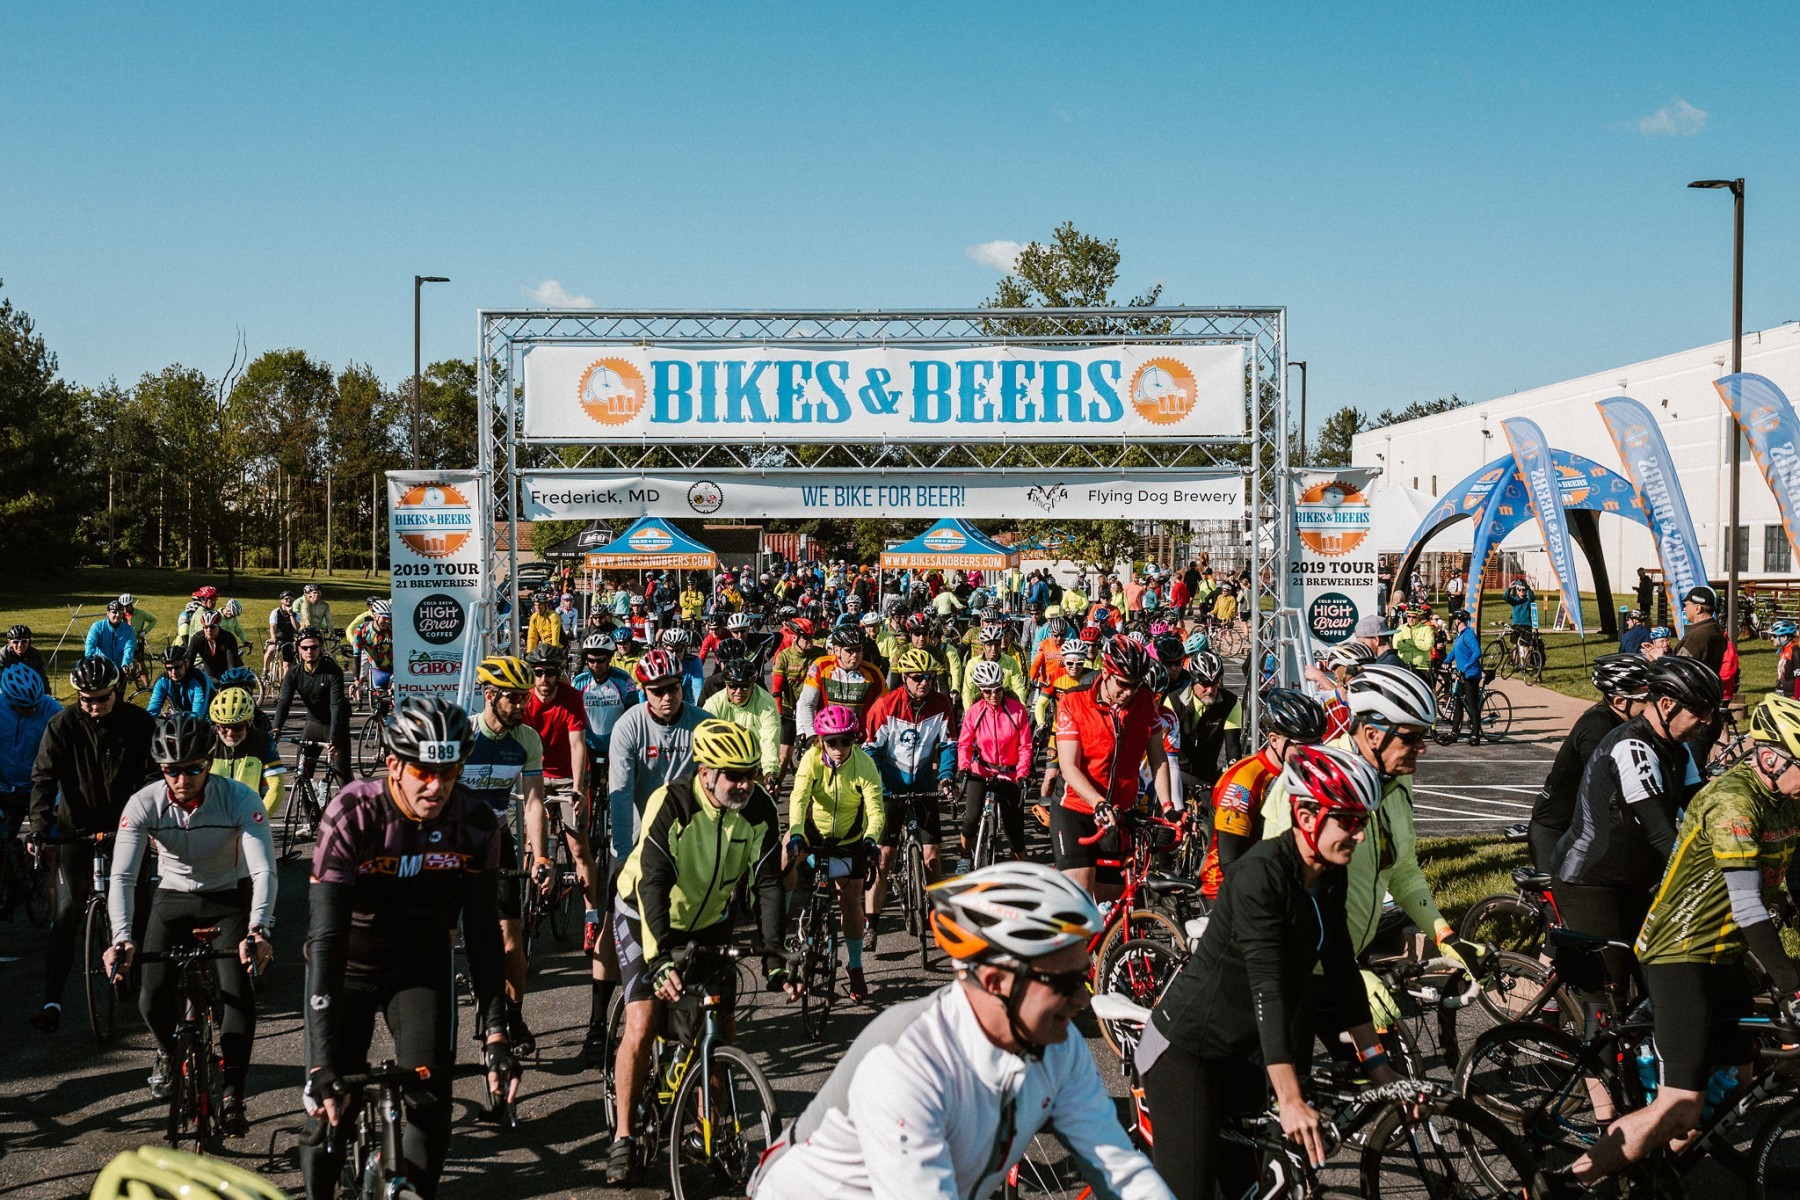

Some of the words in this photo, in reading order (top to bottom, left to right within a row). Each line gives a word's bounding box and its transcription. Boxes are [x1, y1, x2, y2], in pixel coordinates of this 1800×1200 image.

[650, 359, 852, 424] BIKES
[858, 367, 903, 415] &
[909, 360, 1125, 424] BEERS
[1563, 479, 1588, 488] BEERS
[531, 489, 622, 505] Frederick,
[628, 488, 660, 504] MD
[801, 486, 829, 507] WE
[834, 486, 874, 507] BIKE
[878, 486, 912, 507] FOR
[917, 486, 965, 507] BEER!
[1088, 490, 1133, 504] Flying
[1138, 490, 1168, 505] Dog
[1173, 490, 1237, 505] Brewery
[395, 514, 428, 525] BIKES
[429, 516, 436, 524] &
[437, 513, 471, 524] BEERS
[1295, 511, 1326, 523] BIKES
[1327, 513, 1333, 522] &
[1334, 511, 1370, 523] BEERS
[589, 555, 712, 567] WWW.BIKESANDBEERS.COM
[884, 556, 1002, 568] WWW.BIKESANDBEERS.COM
[393, 564, 430, 576] 2019
[433, 563, 479, 575] TOUR
[1291, 561, 1326, 574] 2019
[1329, 561, 1376, 574] TOUR
[396, 580, 407, 588] 21
[410, 579, 478, 588] BREWERIES!
[1293, 577, 1304, 586] 21
[1306, 577, 1374, 586] BREWERIES!
[420, 606, 459, 618] HIGH
[1314, 604, 1353, 617] HIGH
[419, 619, 460, 632] Brew
[1314, 616, 1354, 630] Brew
[399, 683, 482, 692] HOLLYWOD
[428, 745, 454, 759] 989
[459, 776, 480, 785] EAM
